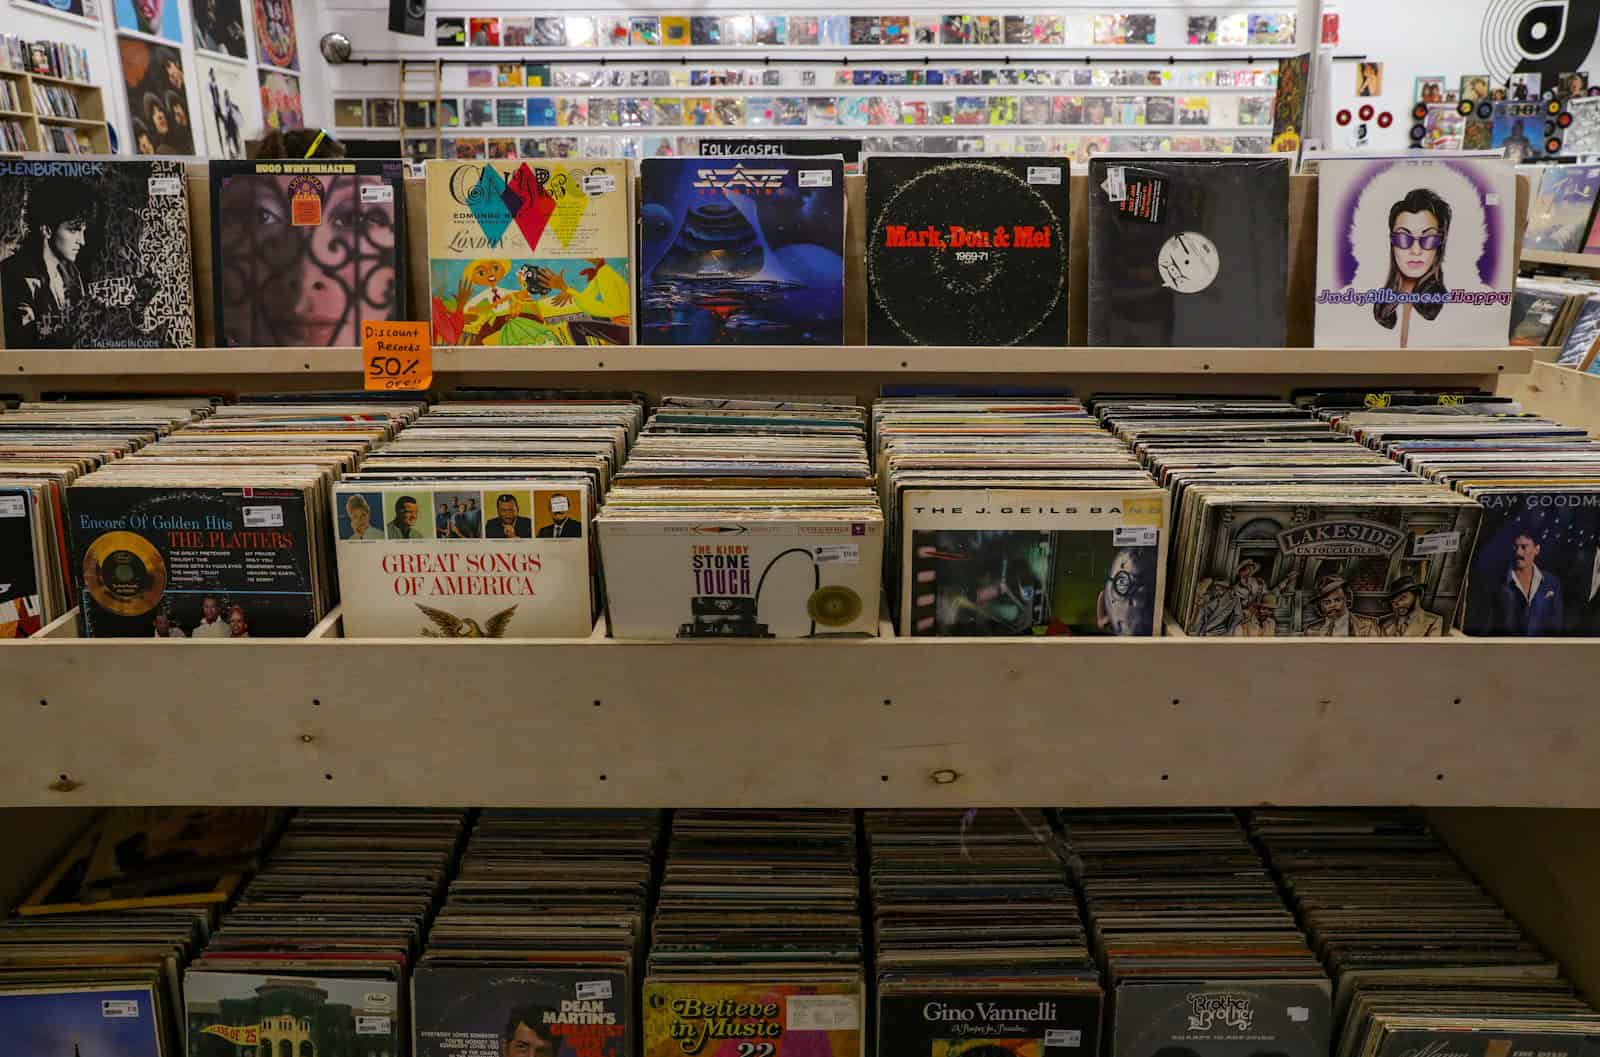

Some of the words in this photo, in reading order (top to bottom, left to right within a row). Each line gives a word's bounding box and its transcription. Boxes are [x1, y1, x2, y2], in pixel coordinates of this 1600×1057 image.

[701, 143, 785, 156] FOLK/GOSPEL
[255, 163, 282, 174] HUGO
[692, 162, 789, 188] SLAVE
[885, 224, 947, 251] Mark,
[950, 225, 990, 248] Don
[993, 225, 1010, 248] &
[1013, 225, 1052, 248] Mel
[365, 326, 418, 338] Discount
[377, 341, 420, 351] Records
[369, 356, 420, 376] 50%
[913, 506, 965, 514] THE
[975, 506, 991, 514] J.
[1000, 506, 1079, 514] GEILS
[1481, 495, 1516, 508] RAY
[1526, 495, 1600, 508] GOODM
[80, 514, 126, 529] Encore
[152, 514, 201, 529] Golden
[205, 515, 233, 530] Hits
[168, 531, 204, 548] THE
[207, 531, 294, 549] PLATTERS
[1286, 524, 1397, 549] LAKESIDE
[692, 545, 711, 554] THE
[716, 545, 750, 554] KIRBY
[381, 553, 460, 574] GREAT
[466, 552, 543, 574] SONGS
[693, 555, 750, 569] STONE
[393, 575, 425, 597] OF
[430, 575, 537, 597] AMERICA
[693, 569, 750, 595] TOUCH
[561, 1000, 604, 1013] DEAN
[671, 998, 778, 1018] Believe
[922, 1001, 975, 1022] Gino
[976, 1001, 1058, 1022] Vannelli
[1186, 992, 1250, 1016] Brother
[542, 1012, 617, 1025] MARTIN'S
[671, 1019, 696, 1038] in
[736, 1042, 776, 1057] 22
